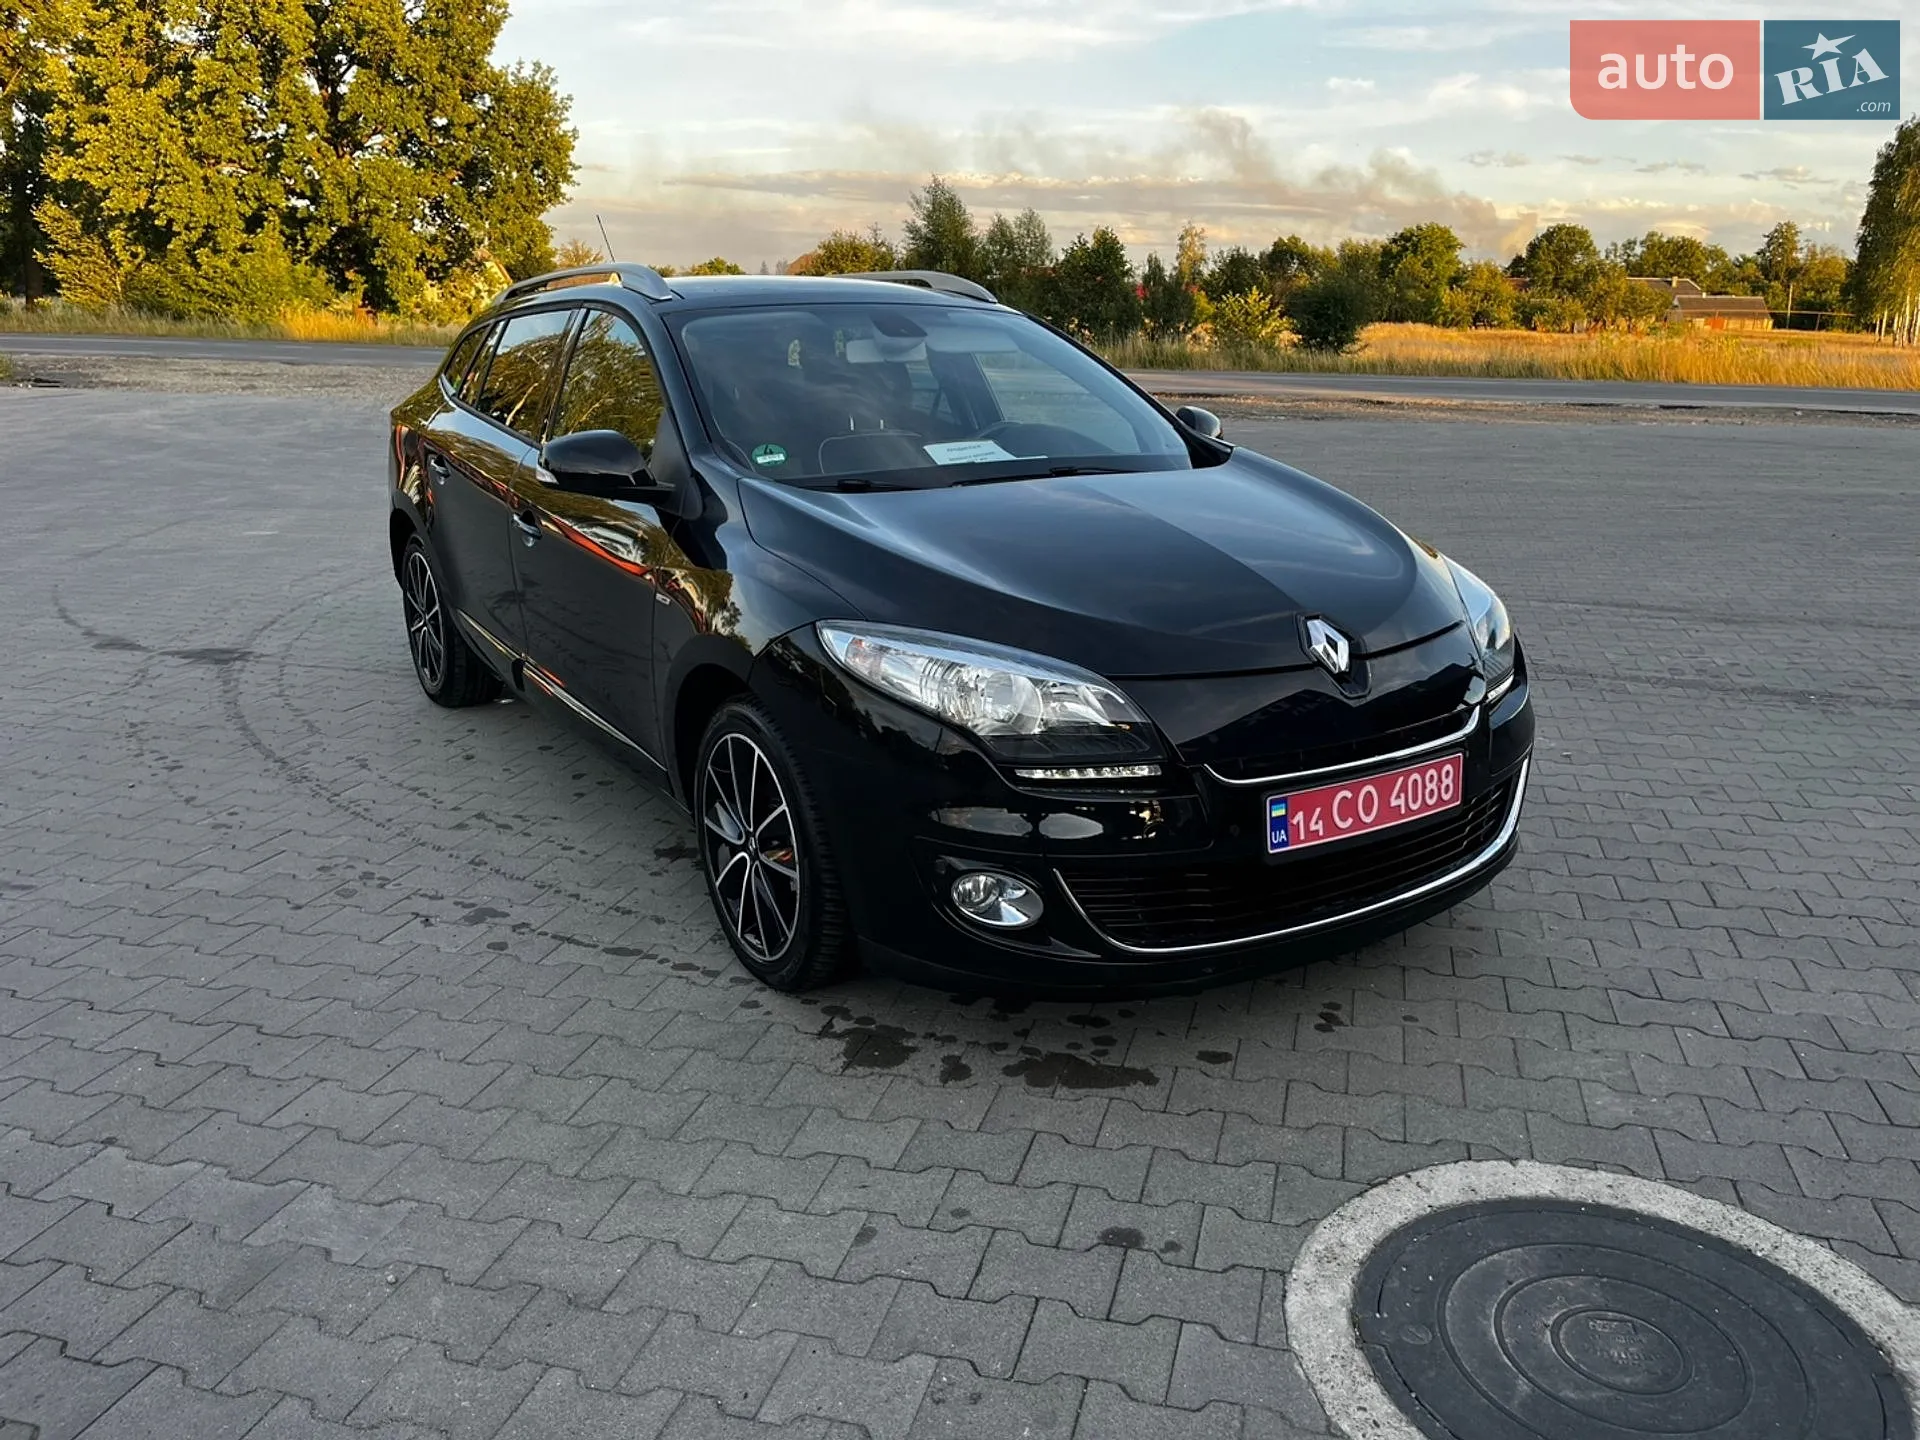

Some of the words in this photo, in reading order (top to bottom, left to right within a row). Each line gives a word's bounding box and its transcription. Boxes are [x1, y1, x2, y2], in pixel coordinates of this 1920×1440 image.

[1290, 807, 1324, 840] 14
[1332, 784, 1379, 829] CO
[1390, 764, 1454, 814] 4088
[1271, 829, 1287, 844] UA
